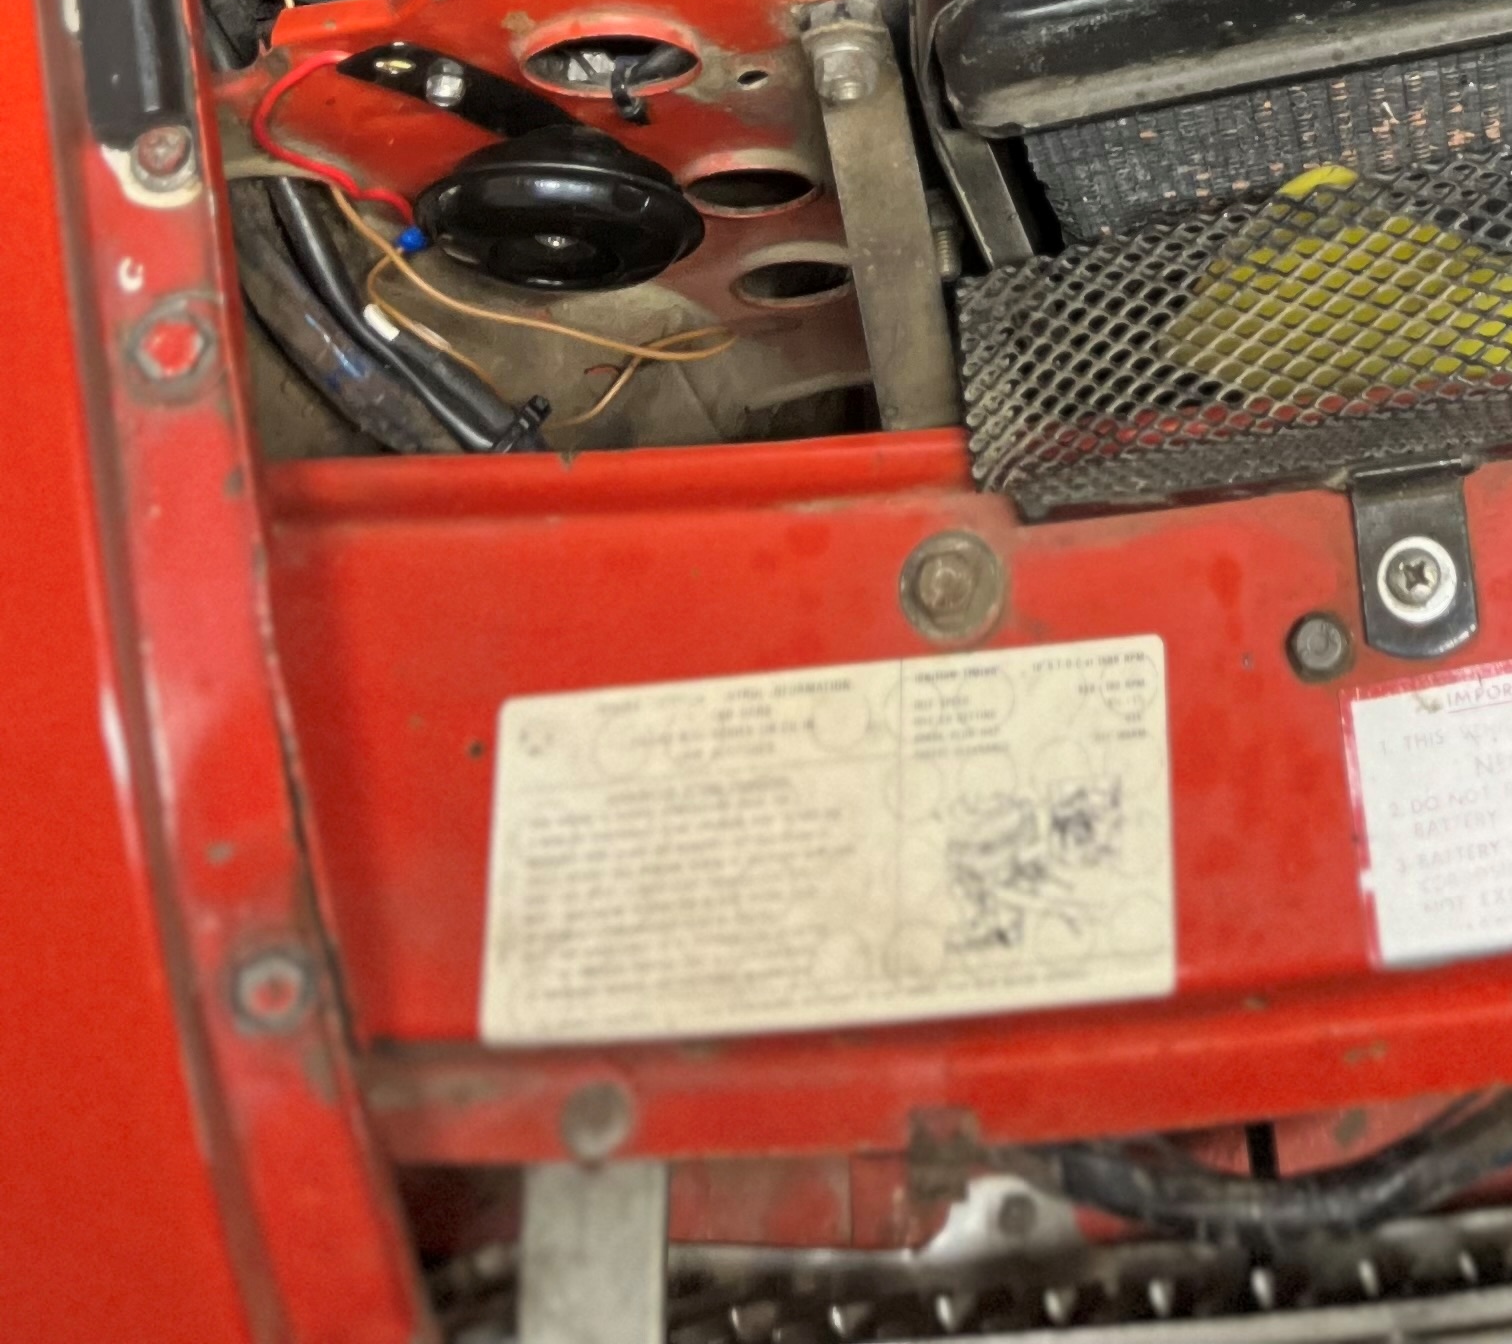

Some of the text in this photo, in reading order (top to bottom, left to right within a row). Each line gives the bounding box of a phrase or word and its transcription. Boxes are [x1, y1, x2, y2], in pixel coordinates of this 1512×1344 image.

[1402, 728, 1445, 751] THIS
[1410, 794, 1440, 814] DO
[1448, 783, 1492, 807] NOT
[1415, 839, 1501, 869] BATTERY
